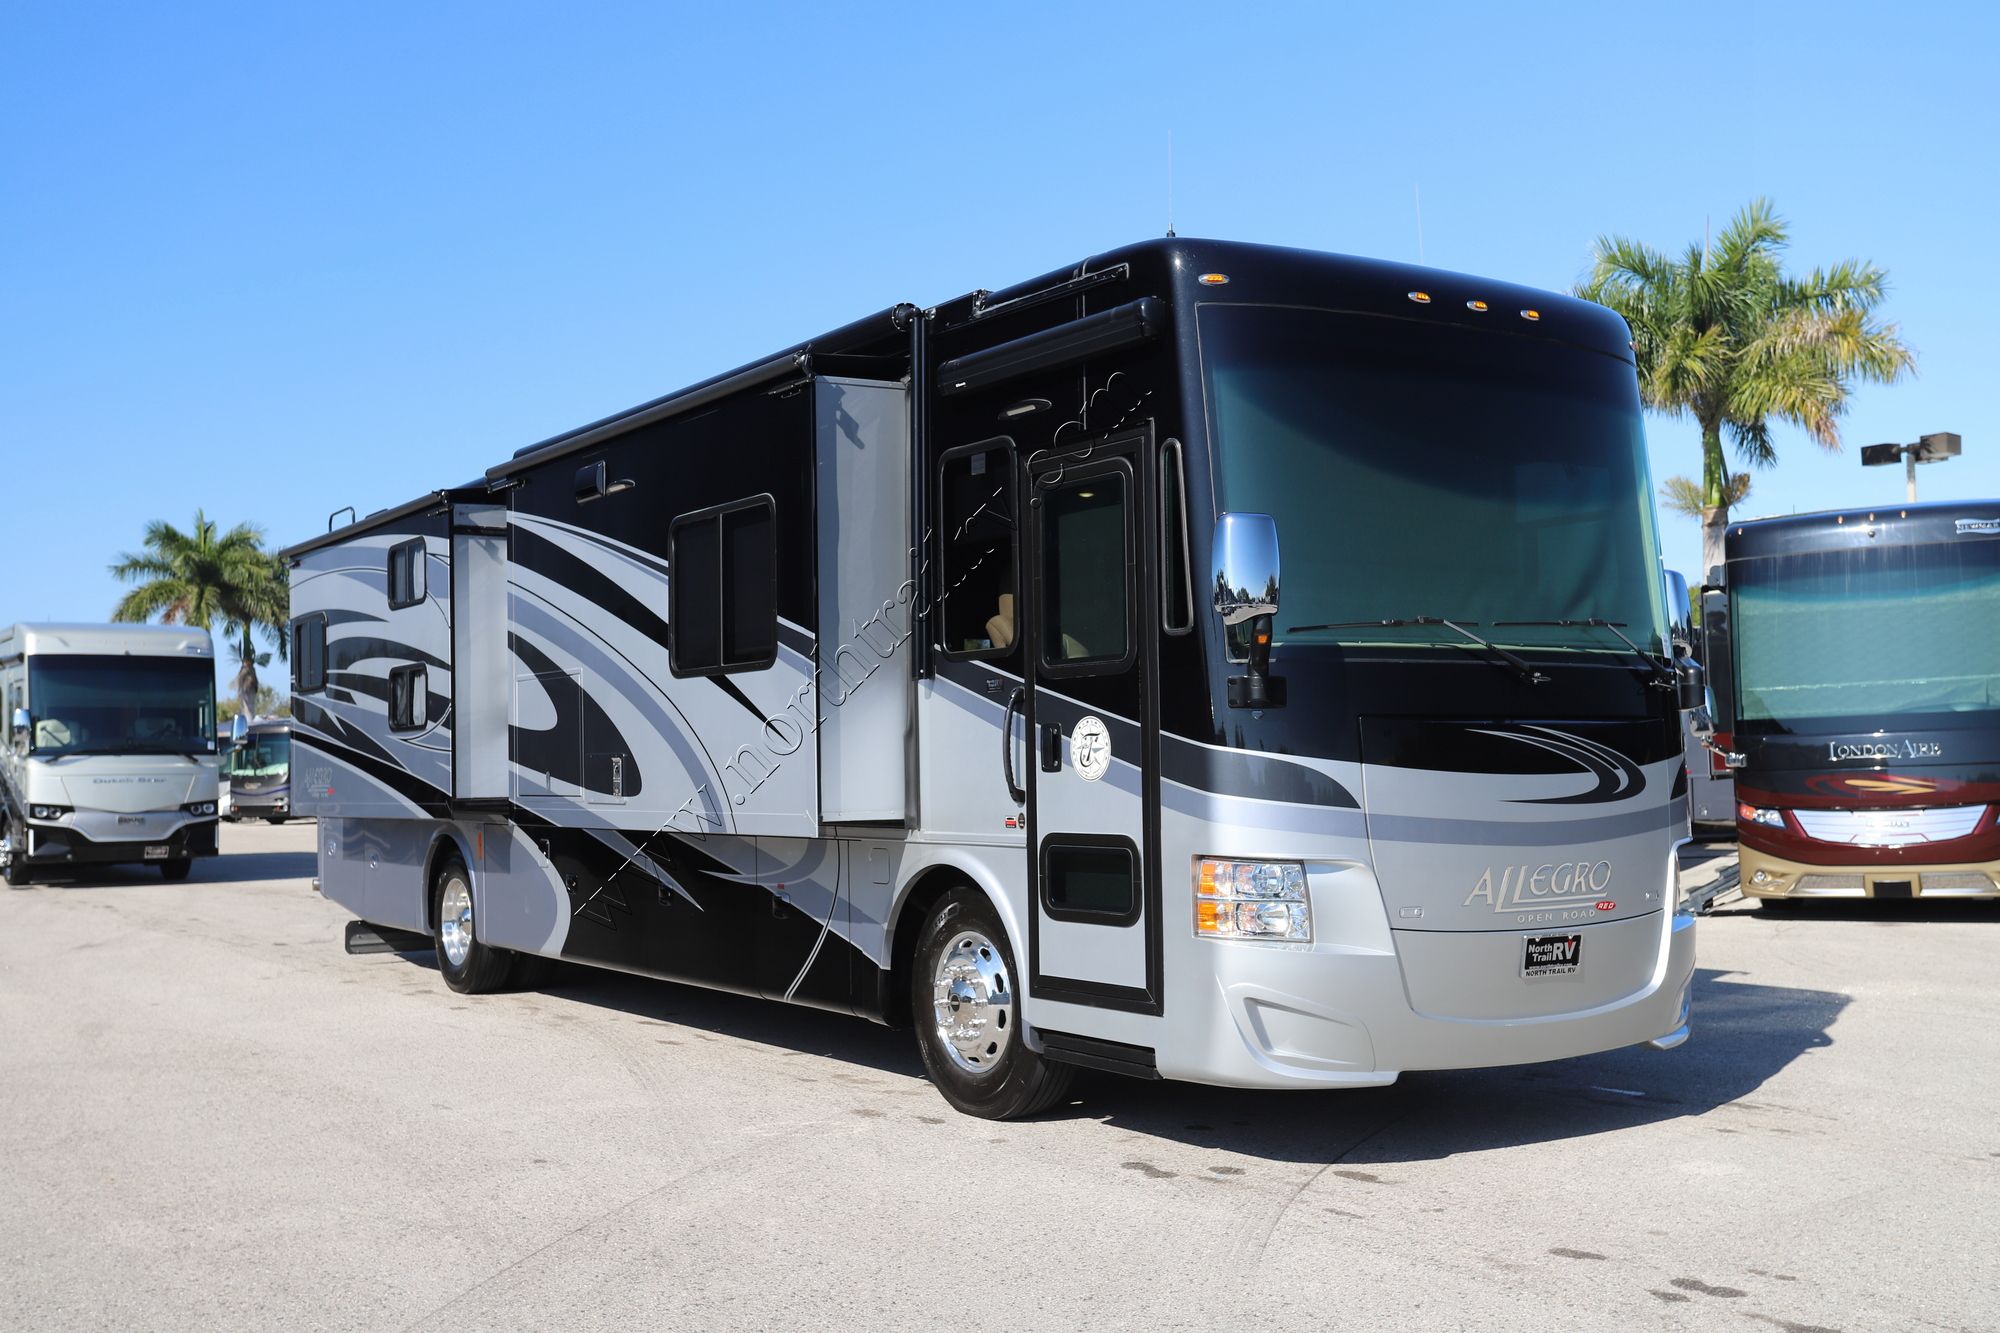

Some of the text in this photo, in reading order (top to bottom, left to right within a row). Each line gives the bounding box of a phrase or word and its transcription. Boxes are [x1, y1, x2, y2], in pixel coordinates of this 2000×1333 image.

[1463, 860, 1612, 913] ALLEGRO
[1597, 902, 1615, 910] RED
[1517, 910, 1596, 924] OPEN ROAD
[1528, 941, 1577, 961] North RV
[1532, 952, 1552, 962] Trail
